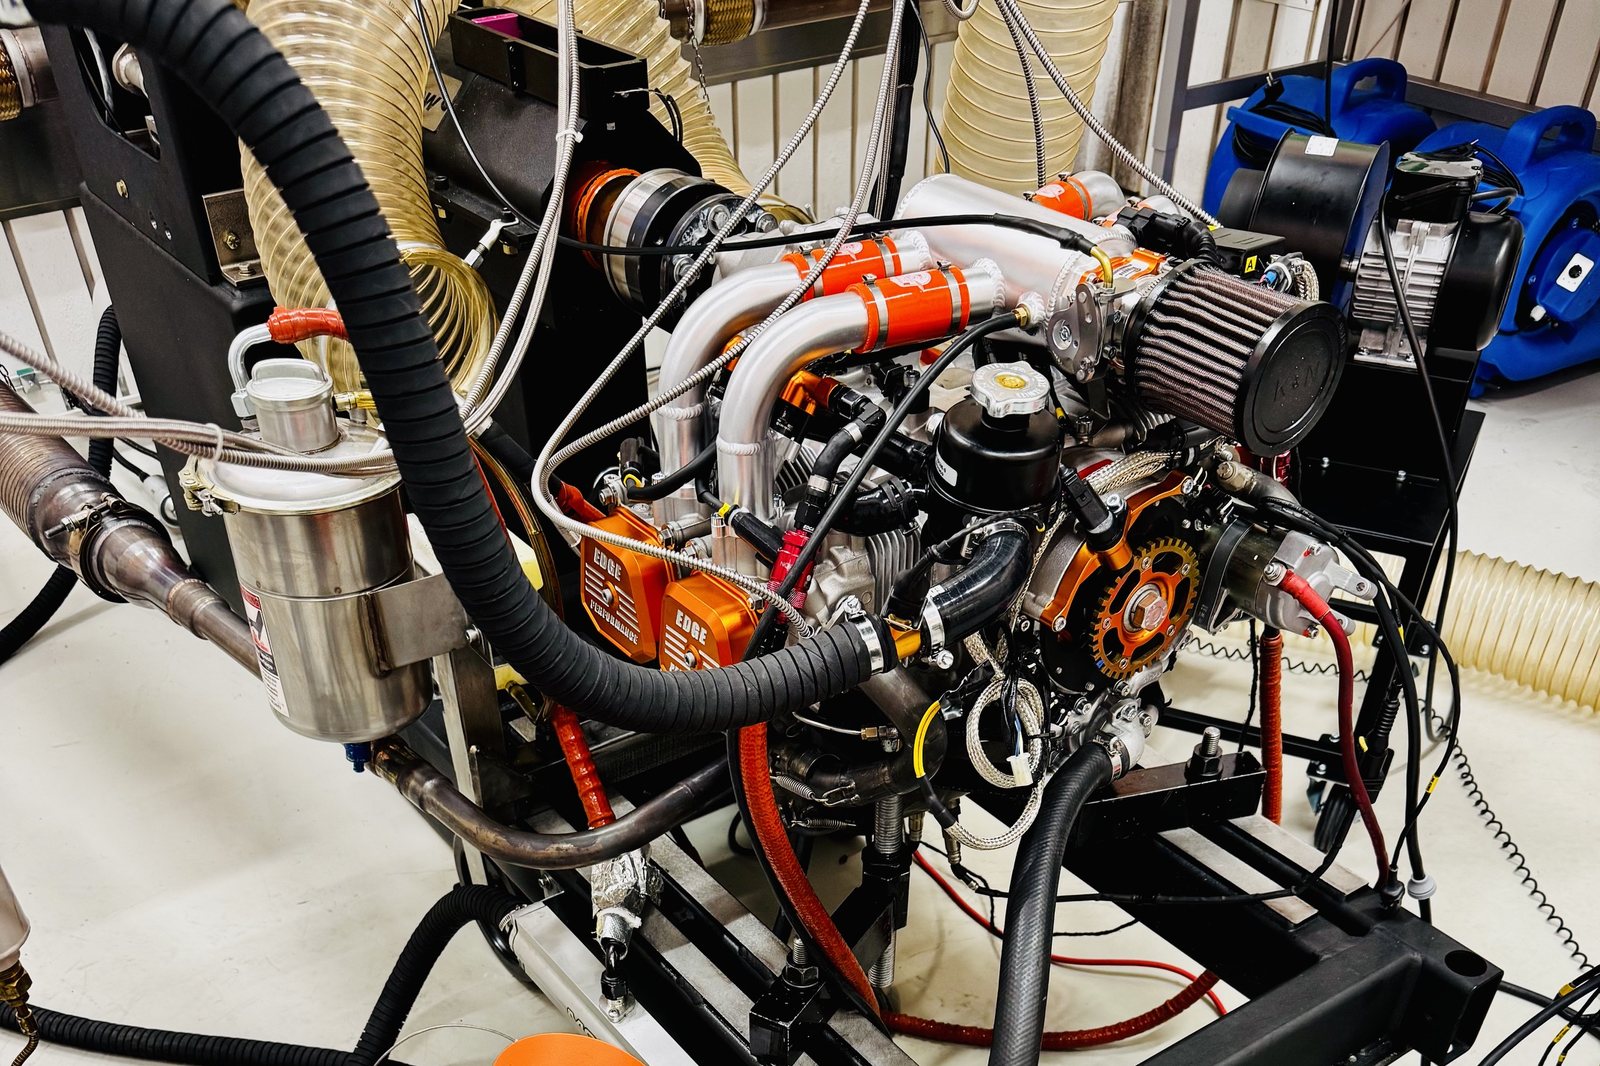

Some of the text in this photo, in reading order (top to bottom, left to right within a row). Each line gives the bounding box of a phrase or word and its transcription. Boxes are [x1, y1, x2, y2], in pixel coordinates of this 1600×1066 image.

[1246, 259, 1254, 272] A
[594, 547, 622, 582] EDGE
[590, 599, 639, 646] PERFORMANCE
[675, 609, 708, 646] EDGE
